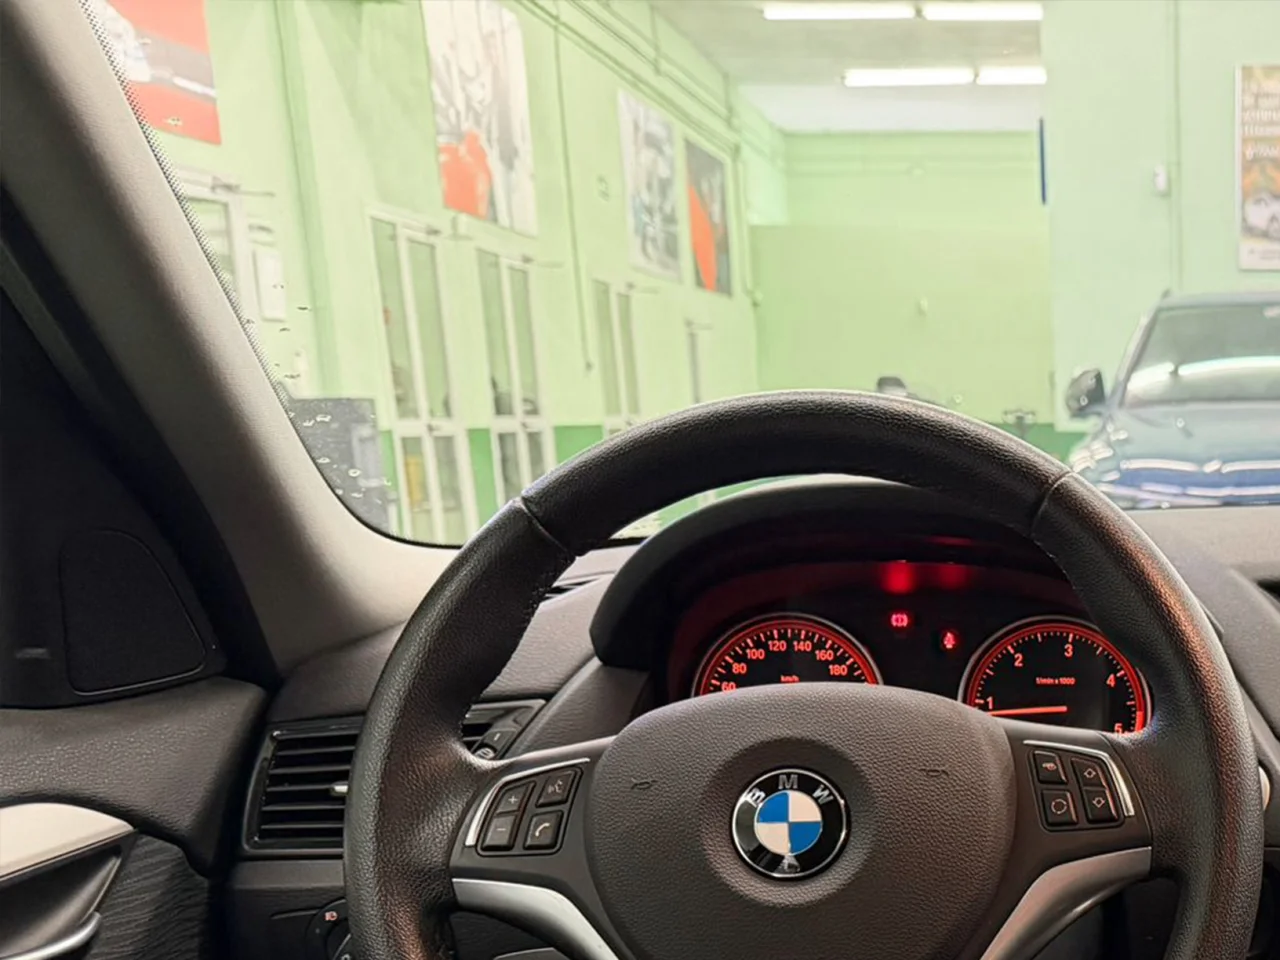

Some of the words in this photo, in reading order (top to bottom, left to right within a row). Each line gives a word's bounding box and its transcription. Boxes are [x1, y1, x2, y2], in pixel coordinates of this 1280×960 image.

[768, 640, 787, 652] 120
[793, 640, 812, 652] 140
[1064, 644, 1073, 657] 3
[746, 649, 765, 660] 100
[815, 650, 833, 661] 160
[1014, 653, 1023, 667] 2
[732, 662, 747, 674] 80
[829, 664, 848, 676] 180
[1106, 673, 1116, 688] 4
[721, 682, 736, 693] 60
[986, 696, 993, 710] 1
[1114, 723, 1123, 735] 5
[746, 774, 834, 808] BMW
